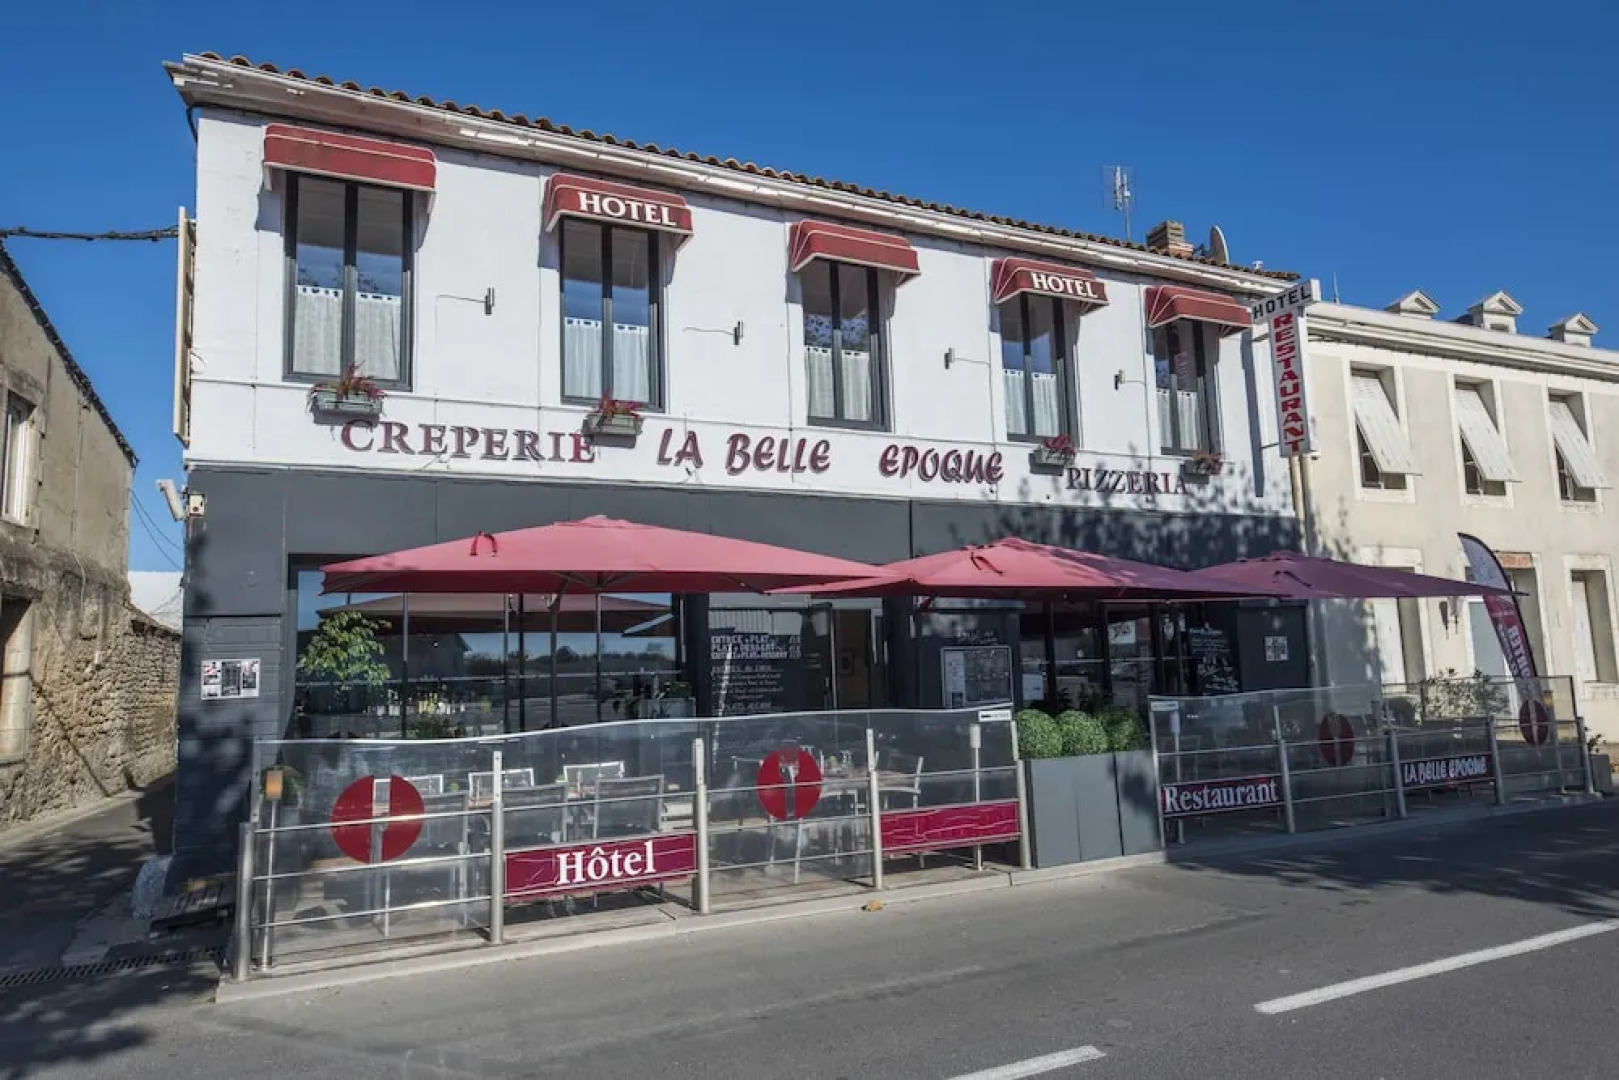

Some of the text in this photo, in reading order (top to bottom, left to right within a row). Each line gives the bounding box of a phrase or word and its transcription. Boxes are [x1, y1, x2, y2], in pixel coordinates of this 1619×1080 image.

[577, 192, 677, 227] HOTEL
[1031, 272, 1098, 299] HOTEL
[1252, 284, 1312, 320] HOTEL
[1273, 311, 1305, 453] RESTAURANT
[340, 419, 595, 464] CREPERIE
[656, 428, 1004, 484] LA BELLE EPOQUE
[1065, 467, 1187, 495] PIZZERIA
[1404, 763, 1417, 783] LA
[1418, 760, 1447, 785] BELLE
[1164, 777, 1279, 813] Restaurant
[556, 839, 657, 886] Hôtel
